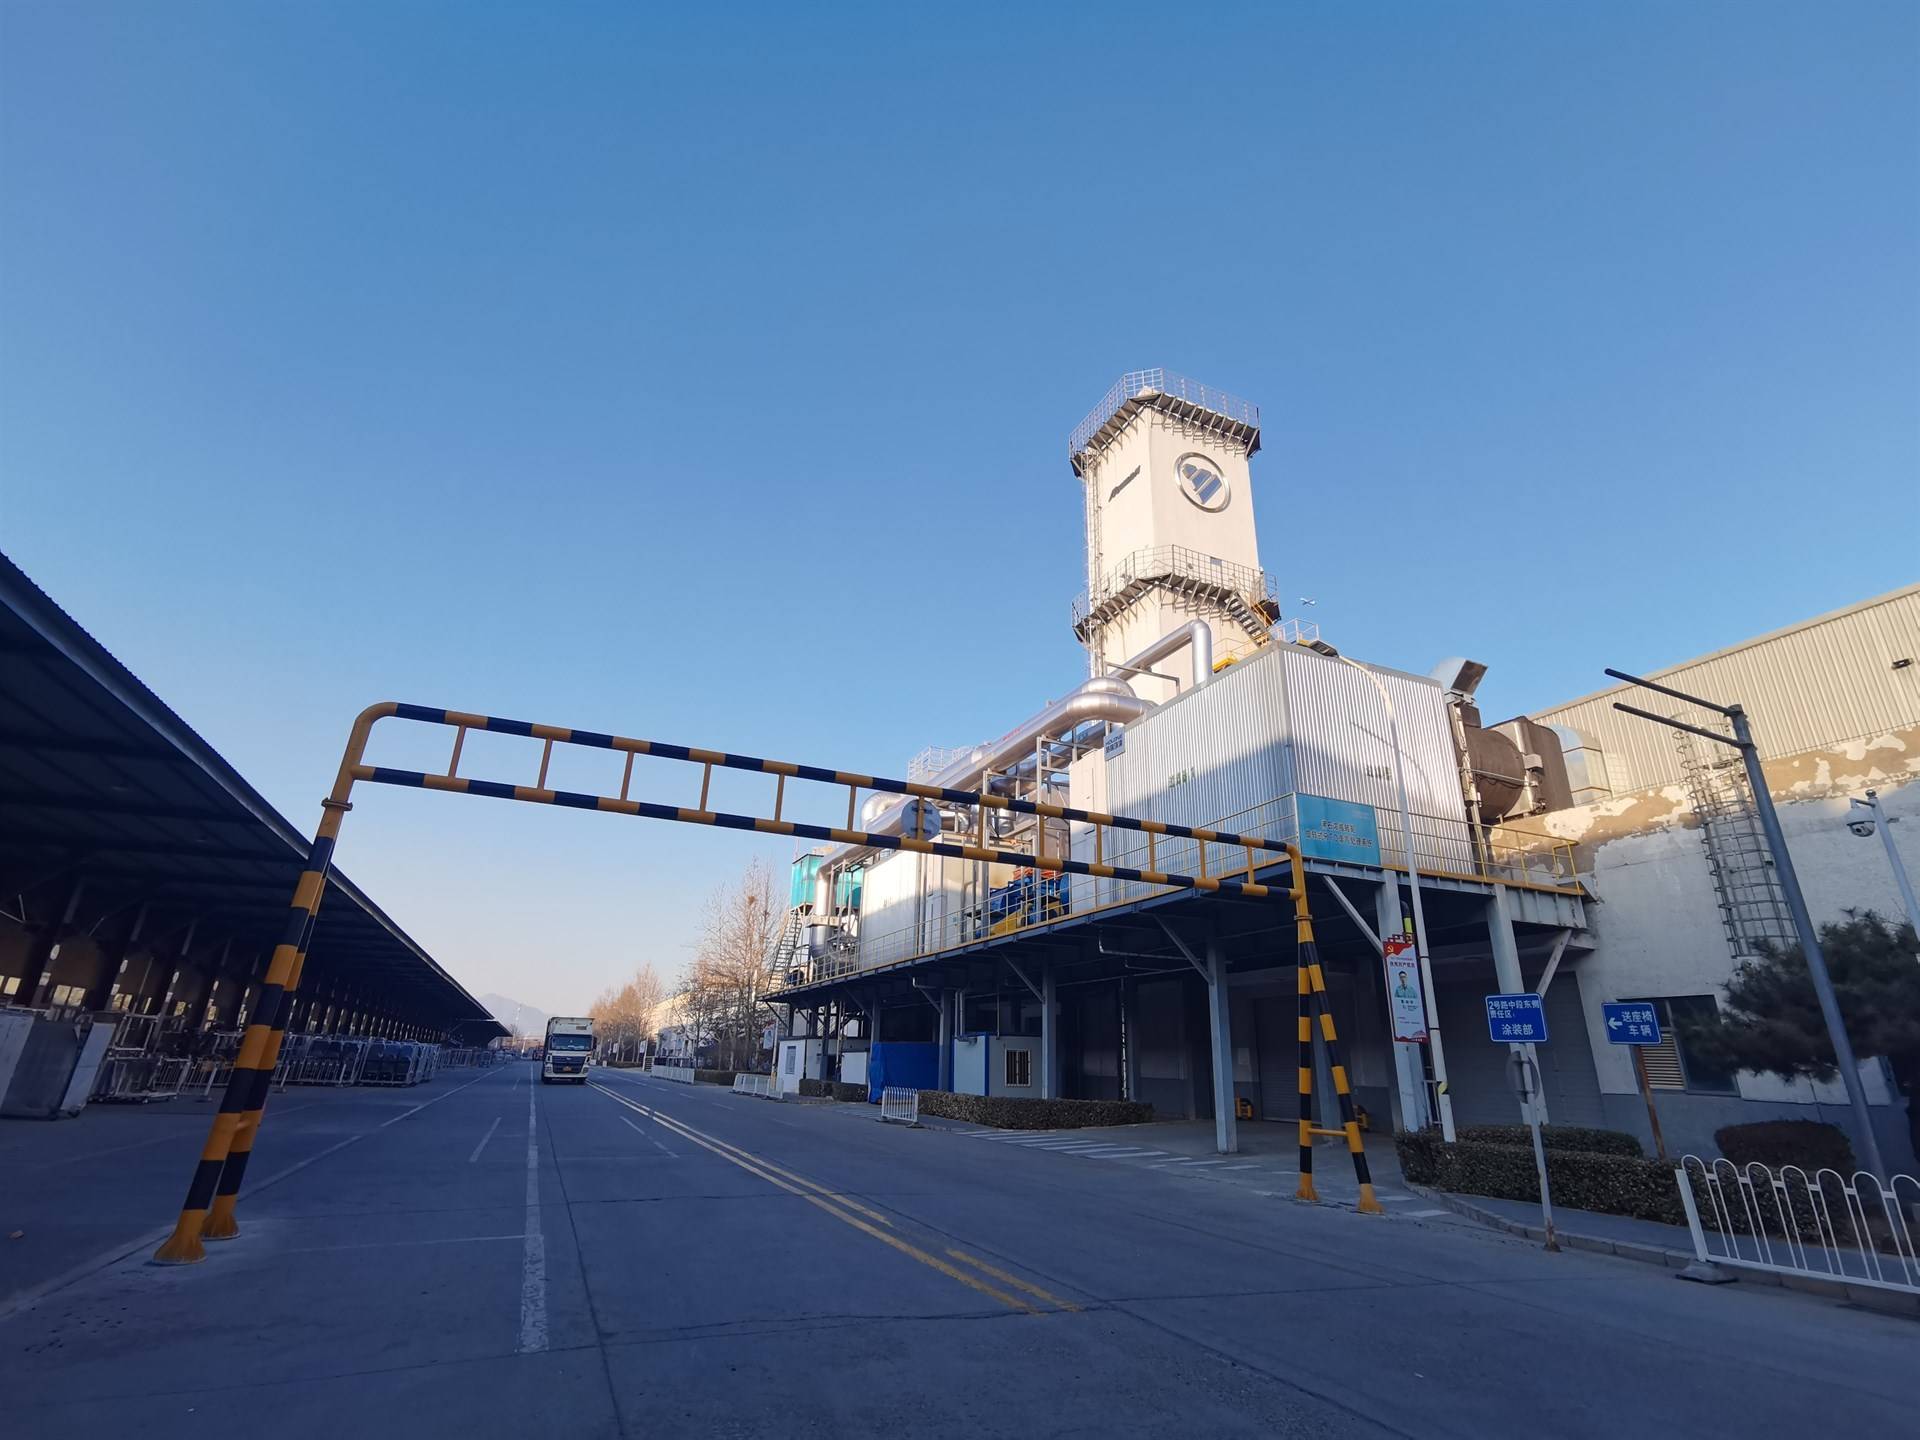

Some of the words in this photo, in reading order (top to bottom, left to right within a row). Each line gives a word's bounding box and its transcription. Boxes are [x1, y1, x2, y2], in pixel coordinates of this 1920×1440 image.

[1621, 1010, 1653, 1022] 送座椅
[1502, 1024, 1533, 1035] 涂装部
[1629, 1025, 1652, 1036] 车辆
